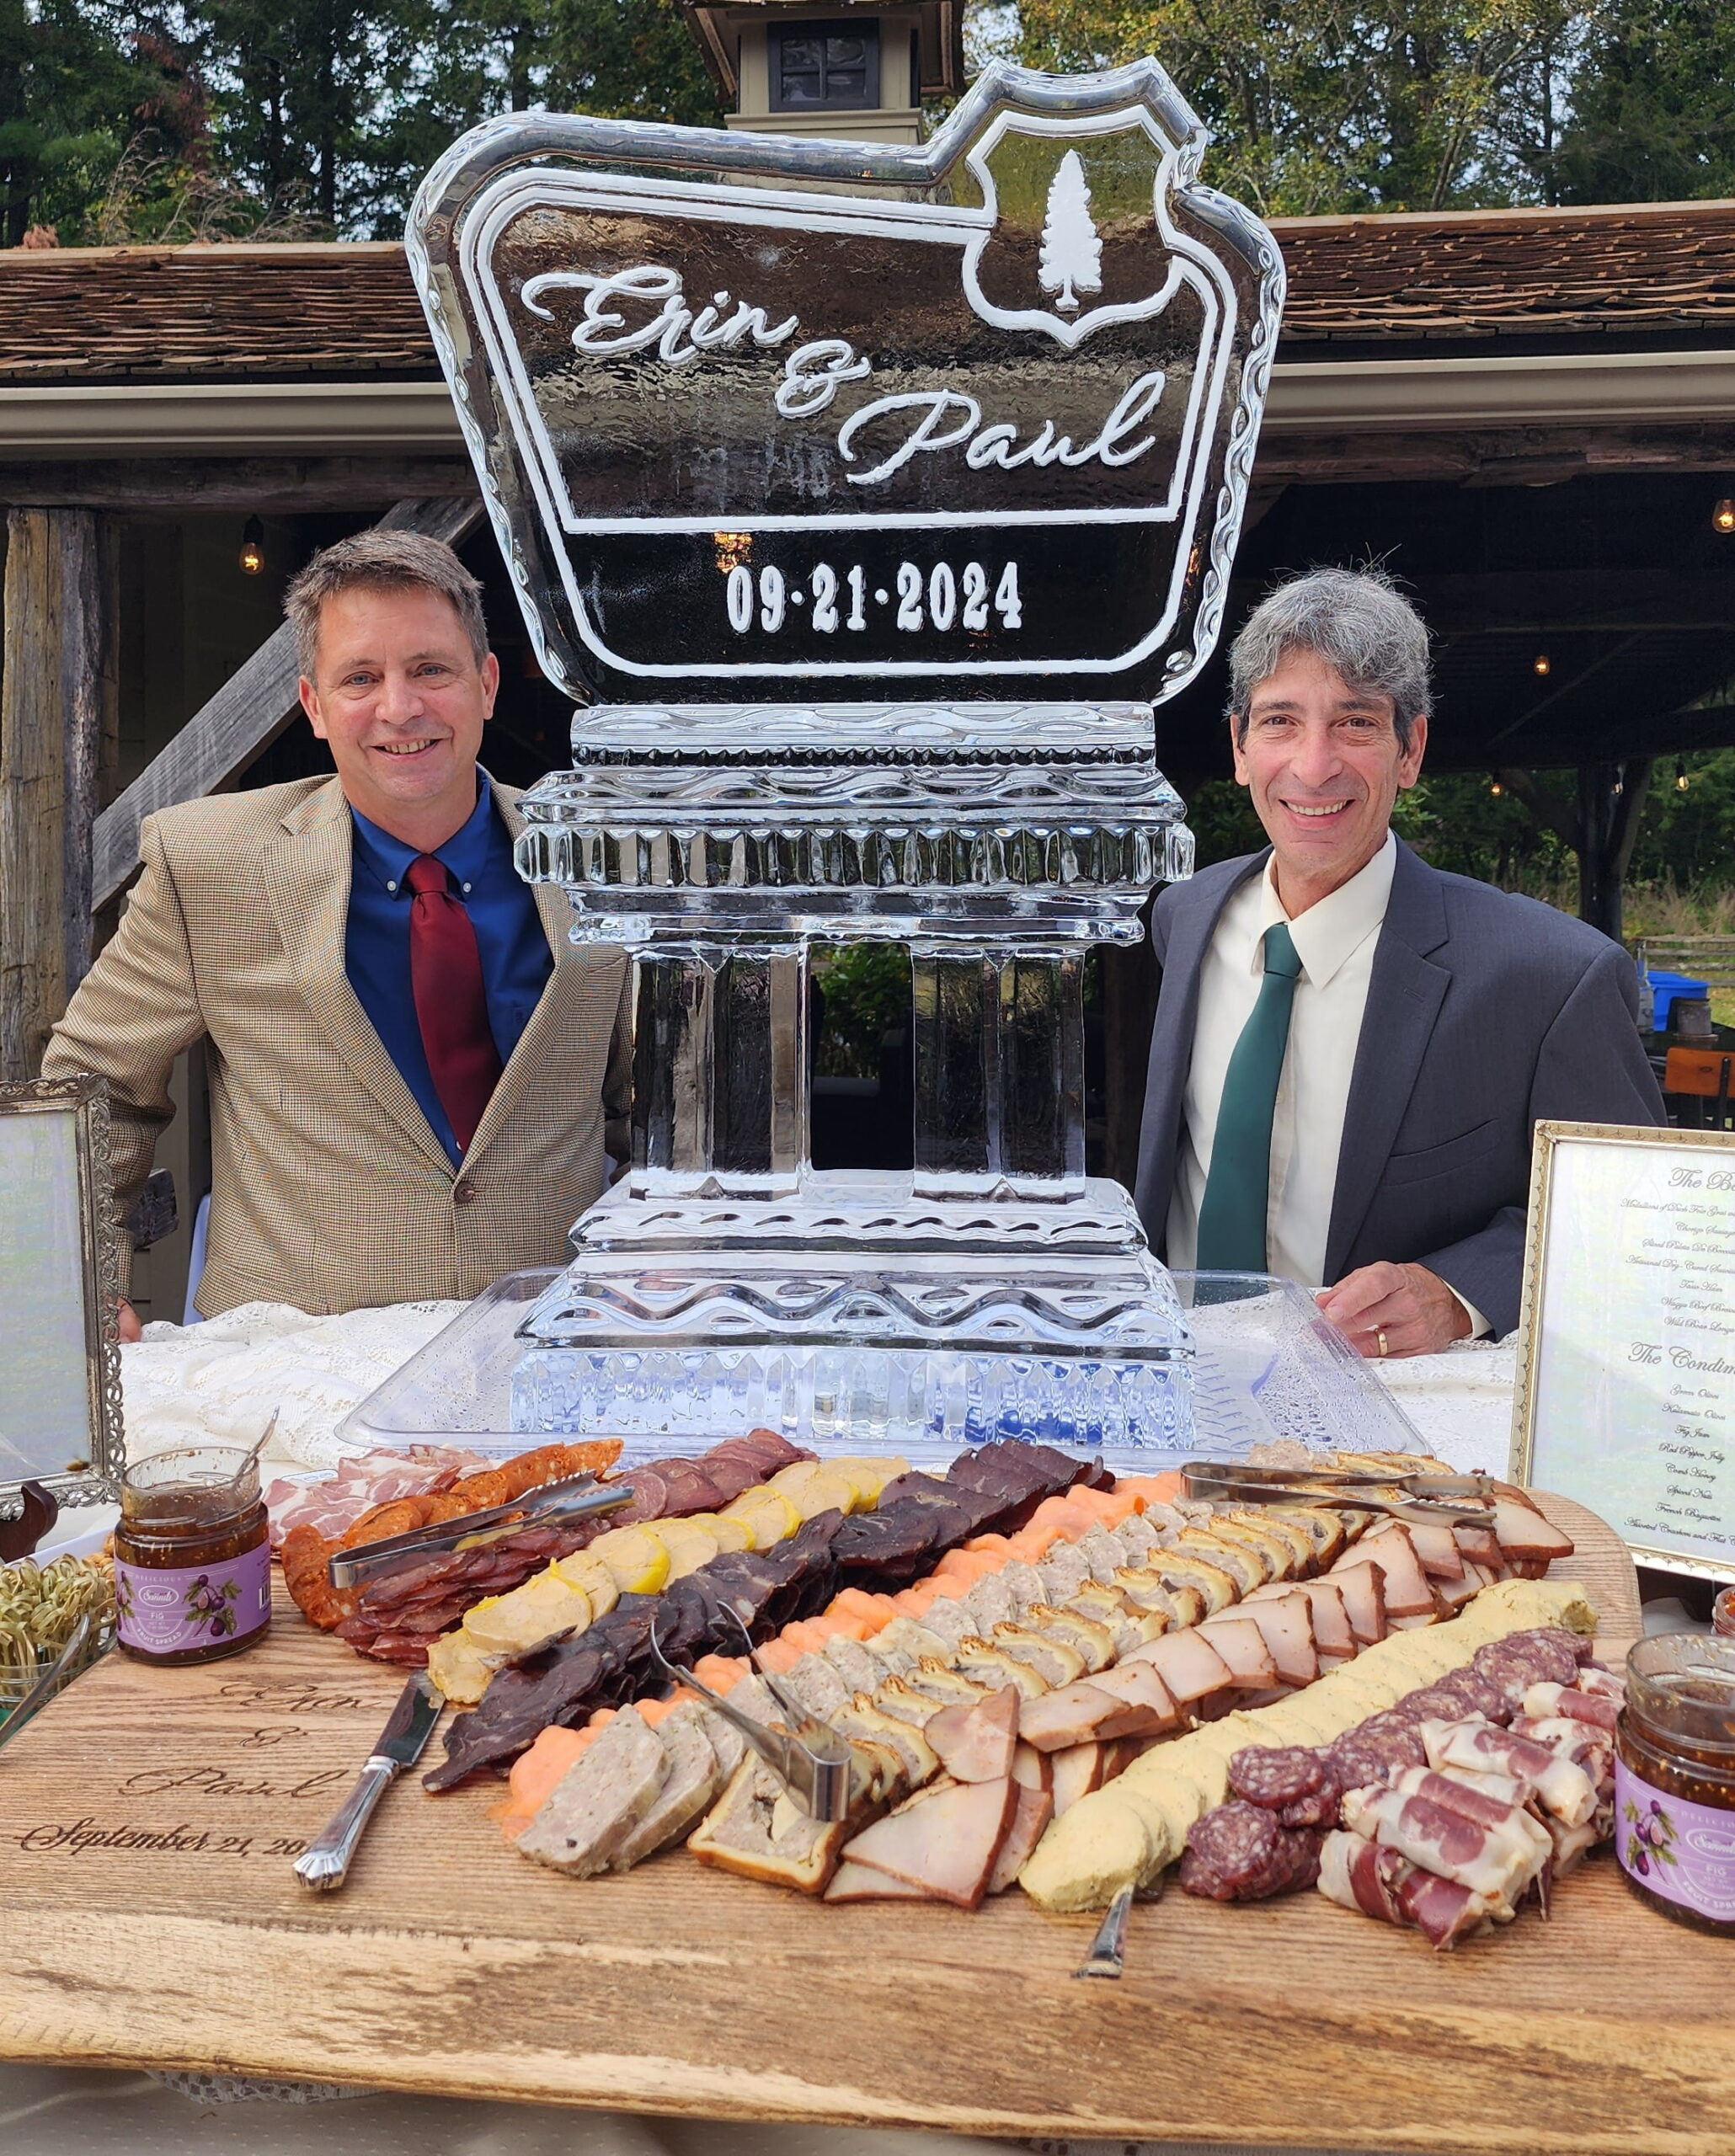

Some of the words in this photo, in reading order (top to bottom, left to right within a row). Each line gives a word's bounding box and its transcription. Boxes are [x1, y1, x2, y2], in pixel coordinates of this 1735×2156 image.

[520, 266, 799, 365] Erin
[775, 339, 872, 419] &
[838, 371, 1166, 486] Paul
[1668, 1167, 1703, 1188] The
[1675, 1221, 1704, 1235] Chorizo
[1700, 1281, 1723, 1292] Ham
[1663, 1316, 1684, 1327] Wild
[1684, 1319, 1707, 1329] Boar
[1628, 1342, 1663, 1364] The
[1674, 1423, 1691, 1438] Fig
[1690, 1428, 1710, 1438] Jam
[1658, 1442, 1679, 1453] Red
[1679, 1445, 1705, 1459] Pepper
[1704, 1450, 1725, 1464] Jelly
[1690, 1466, 1716, 1483] Honey
[1692, 1487, 1712, 1500] Nuts
[1655, 1502, 1683, 1515] French
[1624, 1517, 1658, 1531] Assorted
[1659, 1523, 1692, 1537] Crackers
[1692, 1532, 1708, 1540] and
[150, 1611, 164, 1620] FIG
[136, 1627, 155, 1644] FRUIT
[155, 1631, 183, 1646] SPREAD
[219, 1684, 382, 1713] Erin
[237, 1725, 309, 1748] &
[117, 1766, 350, 1799] Paul
[13, 1817, 211, 1856] September
[211, 1837, 254, 1857] 21,
[262, 1838, 311, 1855] 20
[1706, 1863, 1727, 1877] FIG
